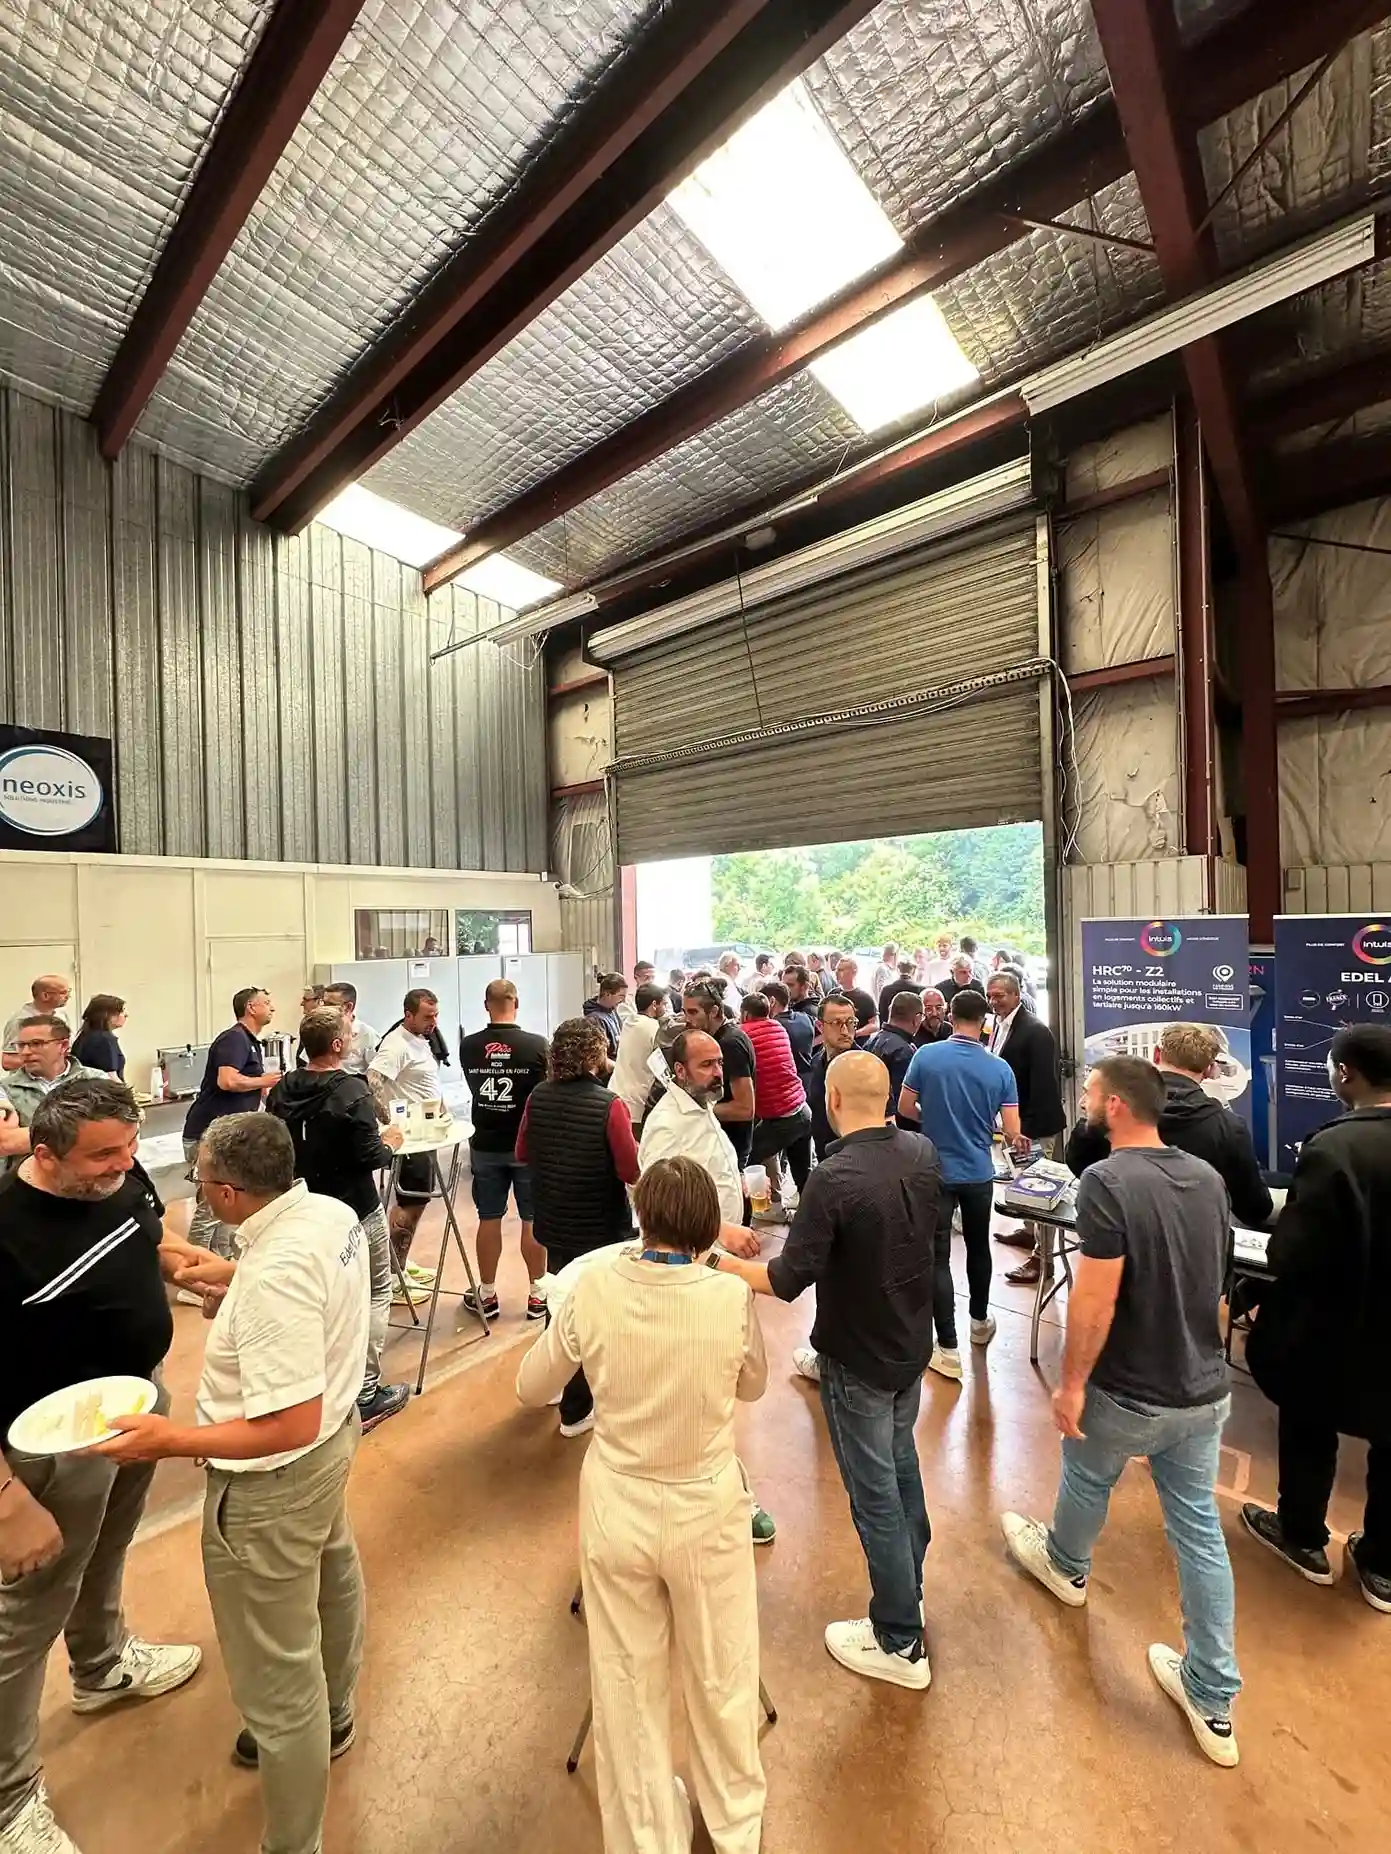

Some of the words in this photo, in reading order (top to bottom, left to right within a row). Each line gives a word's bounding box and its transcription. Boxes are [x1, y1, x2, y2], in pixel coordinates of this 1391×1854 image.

[3, 778, 87, 799] neoxis
[1145, 966, 1164, 977] Z2
[1340, 972, 1385, 983] EDEL
[1092, 986, 1118, 994] simple
[1152, 988, 1203, 997] installations
[1104, 994, 1146, 1003] logements
[1147, 996, 1184, 1004] collectifs
[1092, 1001, 1122, 1009] tertiaire
[479, 1077, 513, 1101] 42
